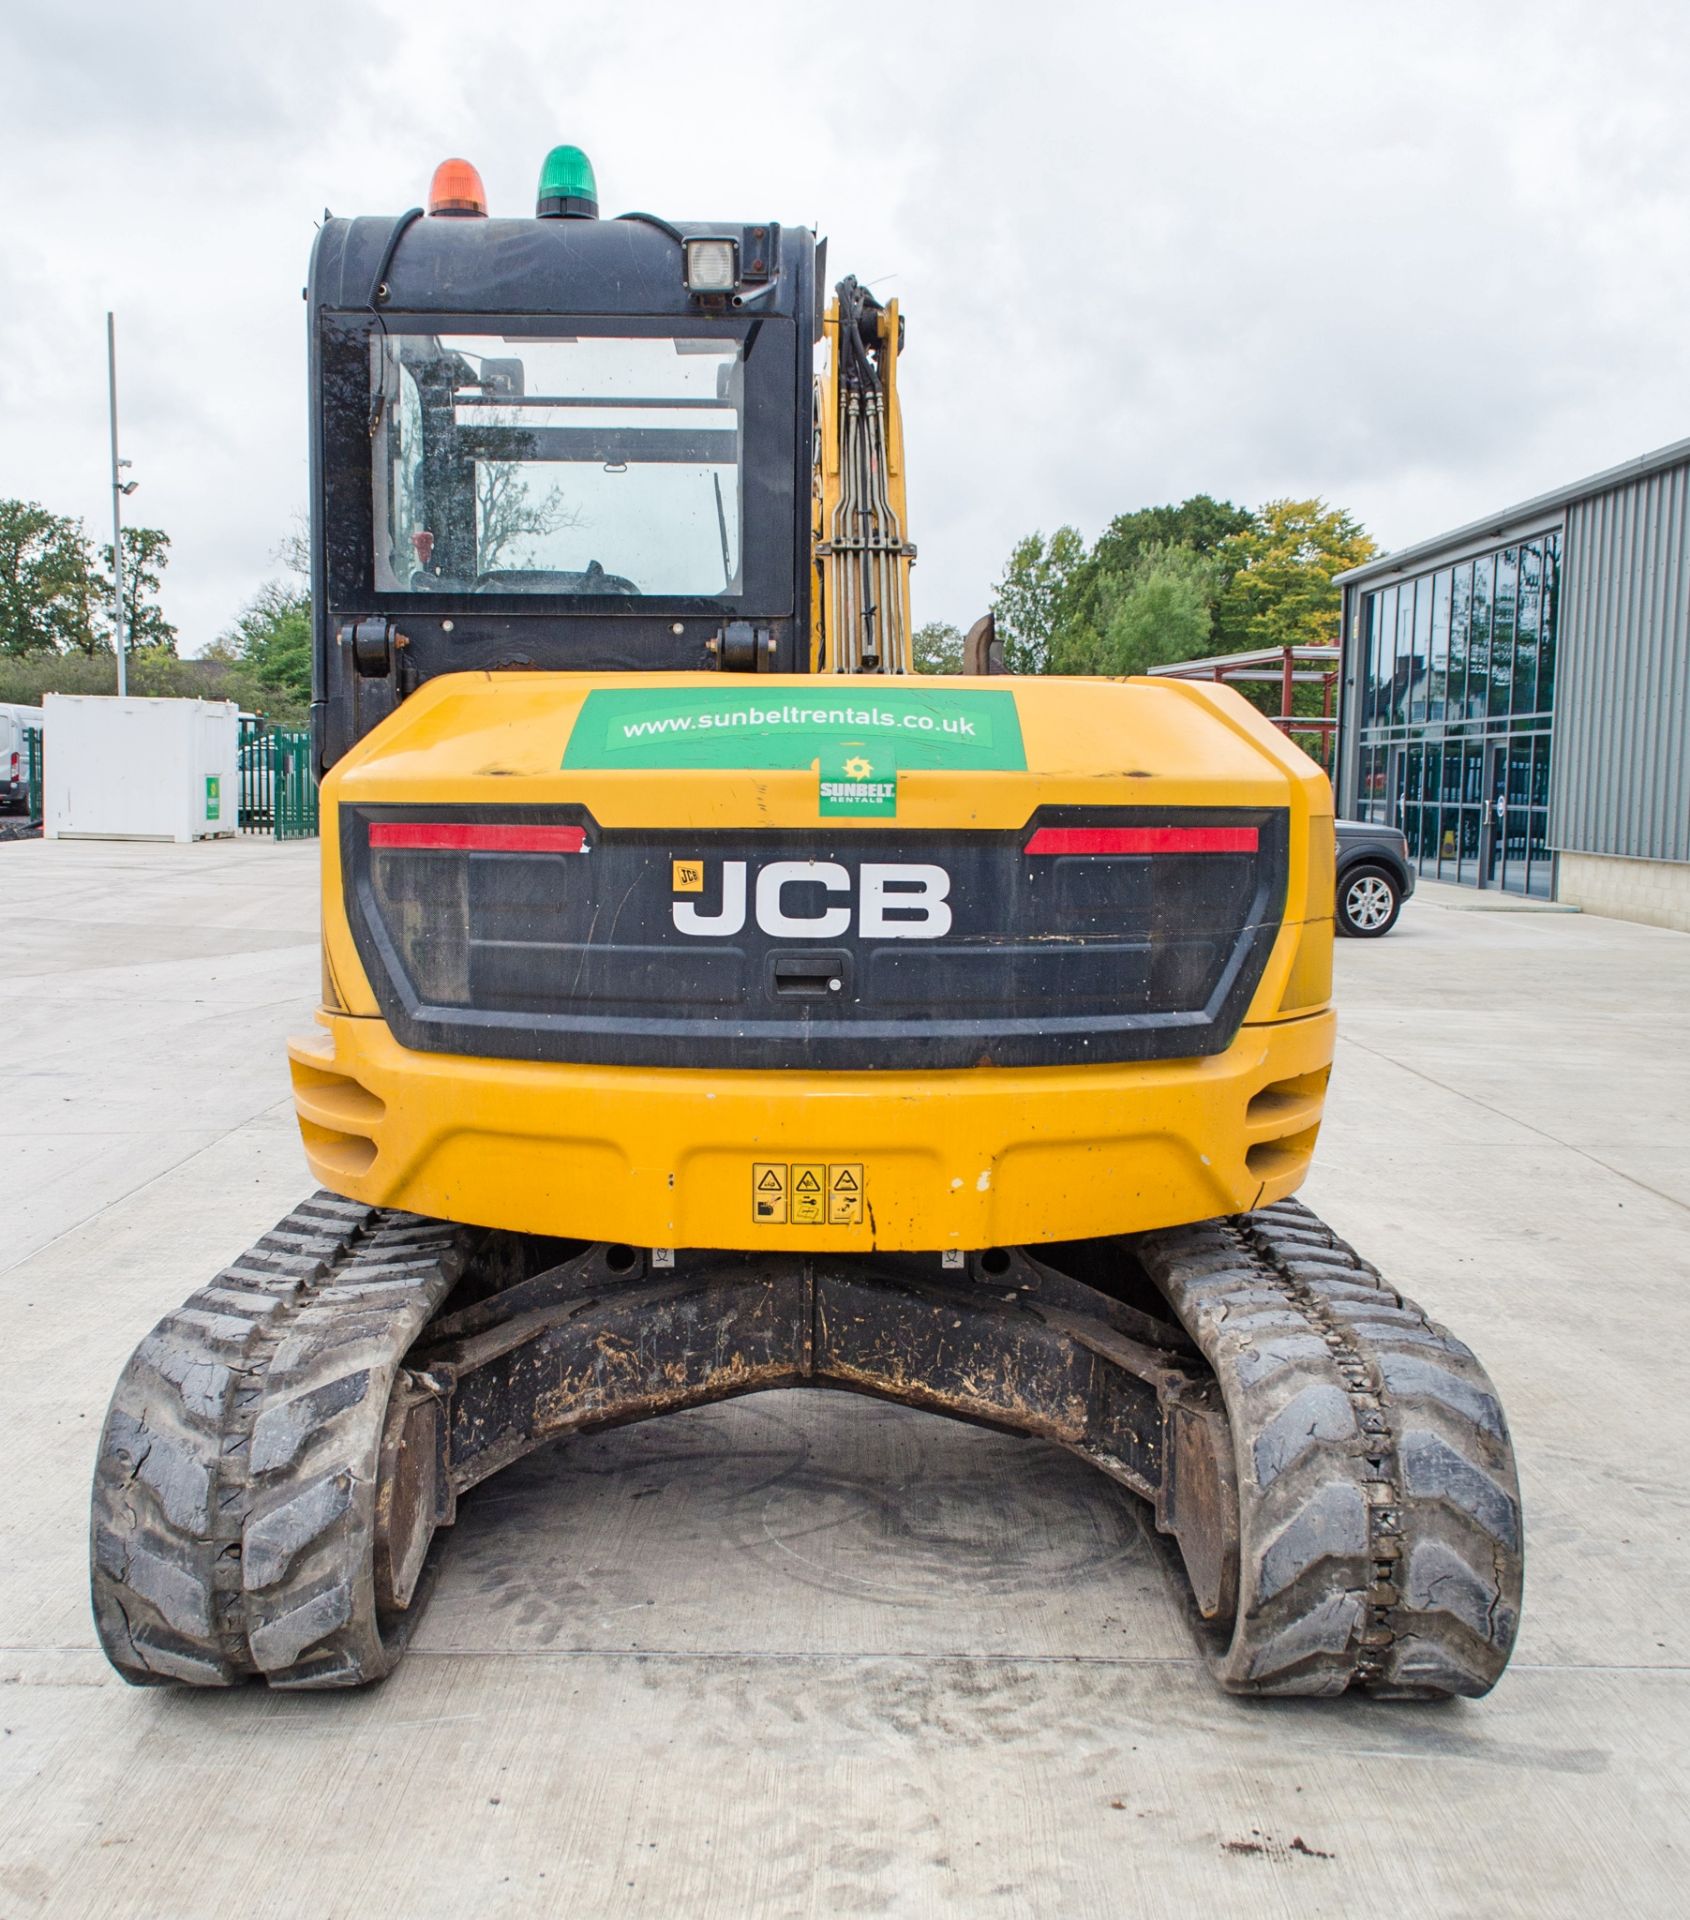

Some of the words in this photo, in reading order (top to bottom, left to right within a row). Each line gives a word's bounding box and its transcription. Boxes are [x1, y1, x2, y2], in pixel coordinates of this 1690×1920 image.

[623, 706, 976, 738] www.sunbeltrentals.co.uk
[820, 783, 894, 797] SUNBELT
[680, 868, 698, 884] JCB
[672, 861, 952, 939] JCB
